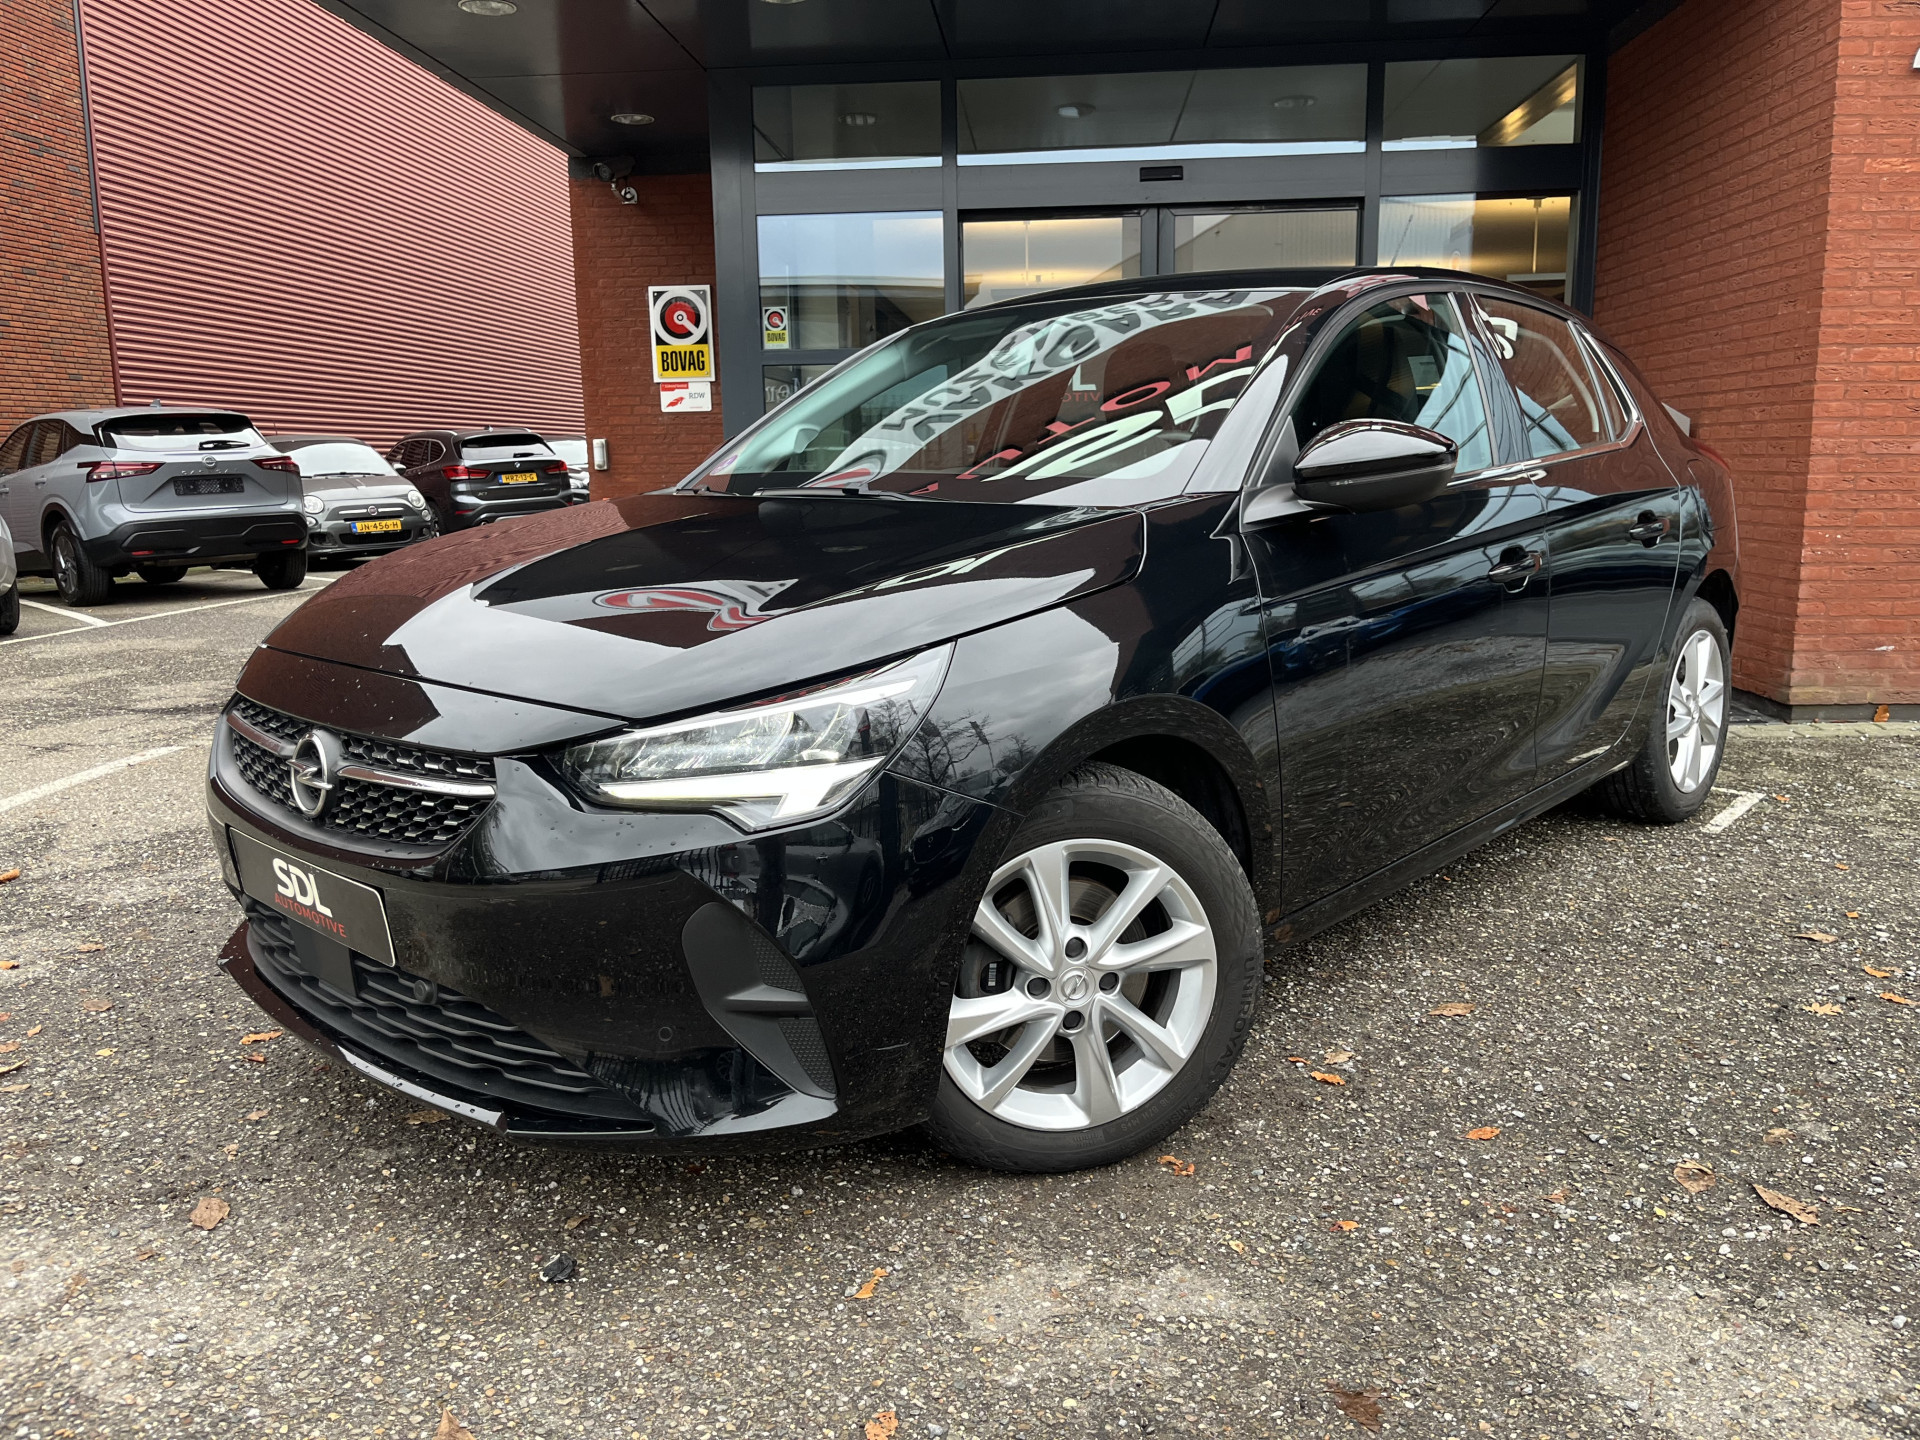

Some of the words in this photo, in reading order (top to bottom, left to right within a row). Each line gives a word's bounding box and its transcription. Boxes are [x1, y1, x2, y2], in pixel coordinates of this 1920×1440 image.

[767, 332, 786, 342] BOVAG
[661, 350, 705, 371] BOVAG
[360, 521, 399, 531] JN-456-H
[272, 857, 333, 918] SDL
[274, 893, 347, 938] AUTOMOTIVE
[1214, 956, 1256, 1073] UNIROYAL
